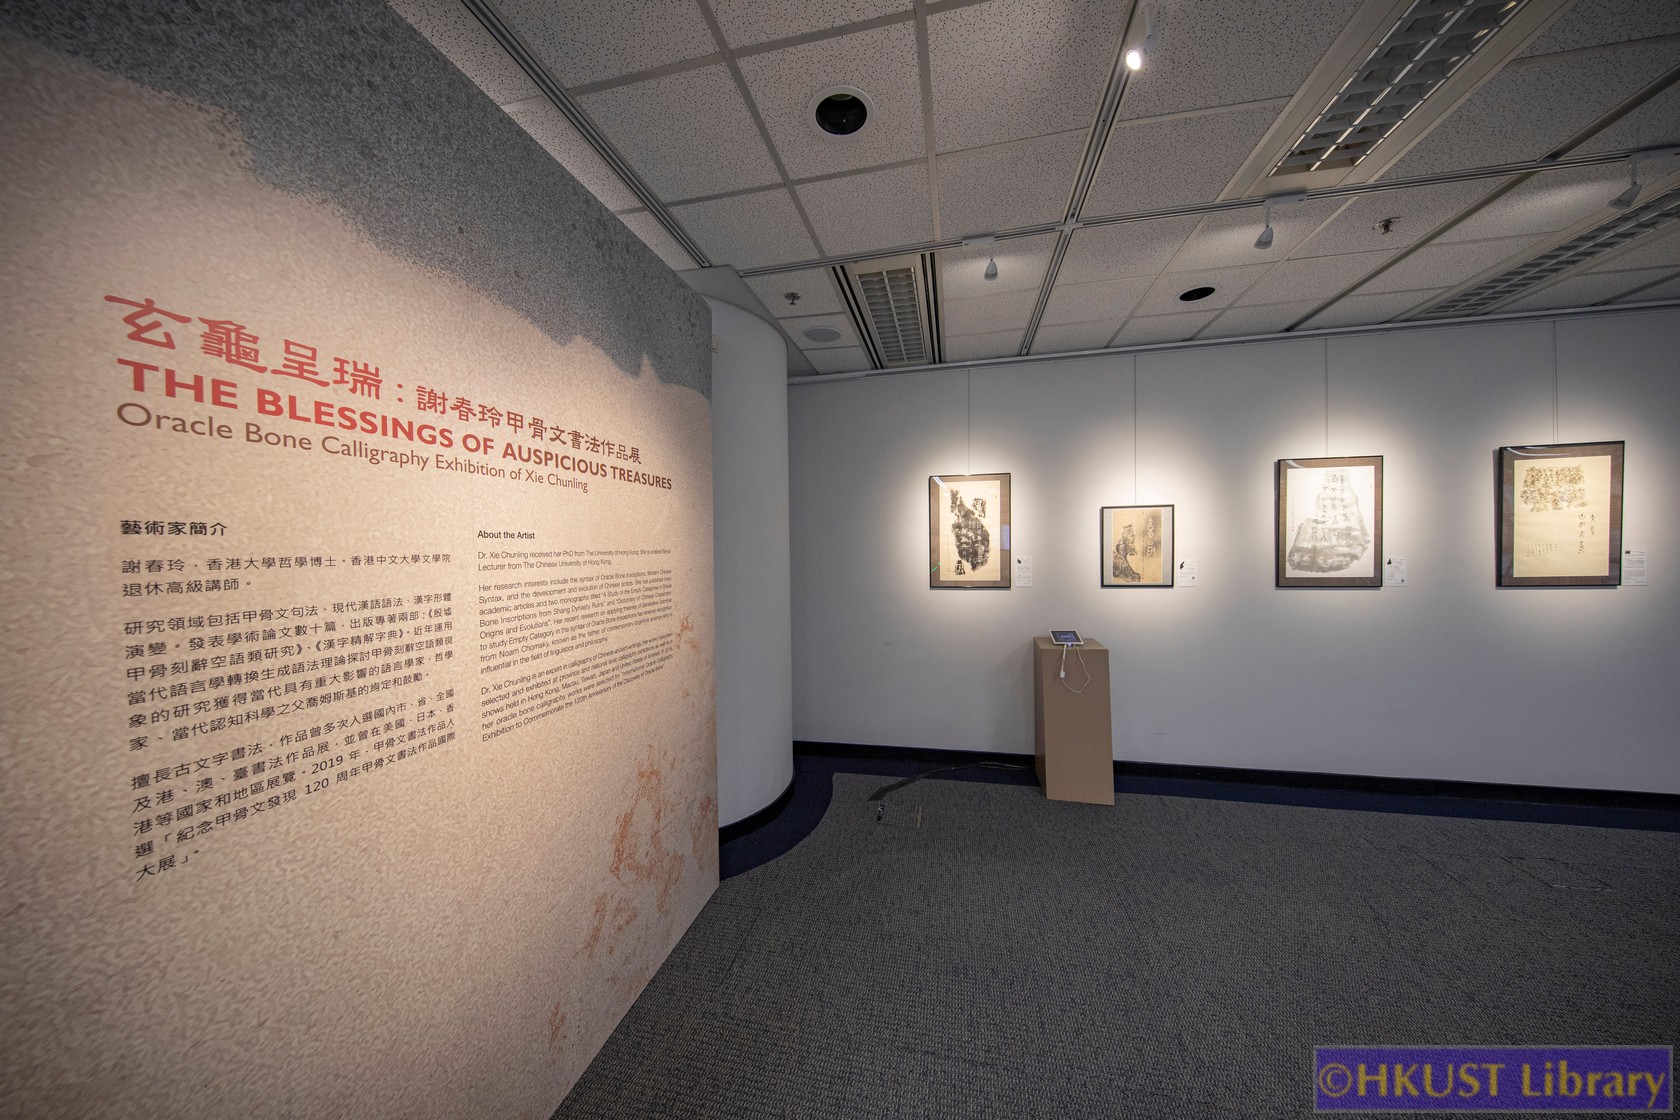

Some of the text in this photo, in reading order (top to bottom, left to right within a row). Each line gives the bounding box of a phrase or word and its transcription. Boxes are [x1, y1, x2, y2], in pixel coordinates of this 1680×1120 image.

[117, 358, 673, 490] THE BLESSINGS OF AUSPICIOUS TREASURES
[117, 402, 589, 493] Oracle Bone Calligraphy Exhibition of Xie Chunling
[120, 520, 228, 536] 藝術家簡介
[477, 530, 536, 539] About the Artist
[478, 551, 488, 560] Dr.
[489, 551, 500, 559] Xie
[501, 551, 528, 560] Chunling
[530, 550, 552, 558] received
[478, 563, 506, 571] Lecturer
[508, 561, 521, 570] from
[523, 561, 535, 569] The
[536, 560, 557, 568] Chinese
[558, 559, 581, 567] University
[478, 584, 492, 592] Her
[494, 581, 522, 591] research
[524, 579, 548, 588] interests
[480, 619, 499, 628] Bone
[500, 613, 537, 624] Inscriptions
[538, 610, 552, 618] from
[553, 607, 571, 615] Shang
[571, 603, 590, 612] Dynasty
[480, 643, 488, 651] to
[489, 639, 508, 649] study
[509, 635, 528, 645] Empty
[530, 630, 554, 641] Category
[570, 622, 585, 632] syntax
[591, 619, 605, 627] Oracle
[481, 653, 497, 663] from
[499, 649, 520, 658] Noam
[521, 642, 550, 653] Chomsky,
[552, 637, 569, 645] known
[481, 660, 512, 674] influential
[512, 658, 519, 666] in
[520, 655, 530, 664] the
[531, 653, 542, 661] field
[550, 645, 575, 656] linguistics
[481, 692, 510, 707] selected
[511, 687, 524, 697] and
[525, 679, 551, 693] exhibited
[560, 670, 580, 682] province
[581, 666, 590, 674] and
[591, 660, 607, 670] national
[481, 705, 504, 719] shows
[506, 700, 519, 711] held
[528, 694, 544, 703] Hong
[598, 668, 611, 677] Japan
[481, 721, 494, 730] her
[496, 712, 517, 725] oracle
[519, 706, 535, 717] bone
[536, 694, 566, 710] calligraphy
[567, 688, 582, 698] works
[584, 682, 595, 691] were
[596, 674, 614, 687] selected
[483, 723, 514, 742] Exhibition
[515, 721, 522, 729] to
[523, 704, 564, 725] Commemorate
[565, 701, 573, 709] the
[588, 686, 611, 699] Anniversary
[305, 777, 329, 795] 120
